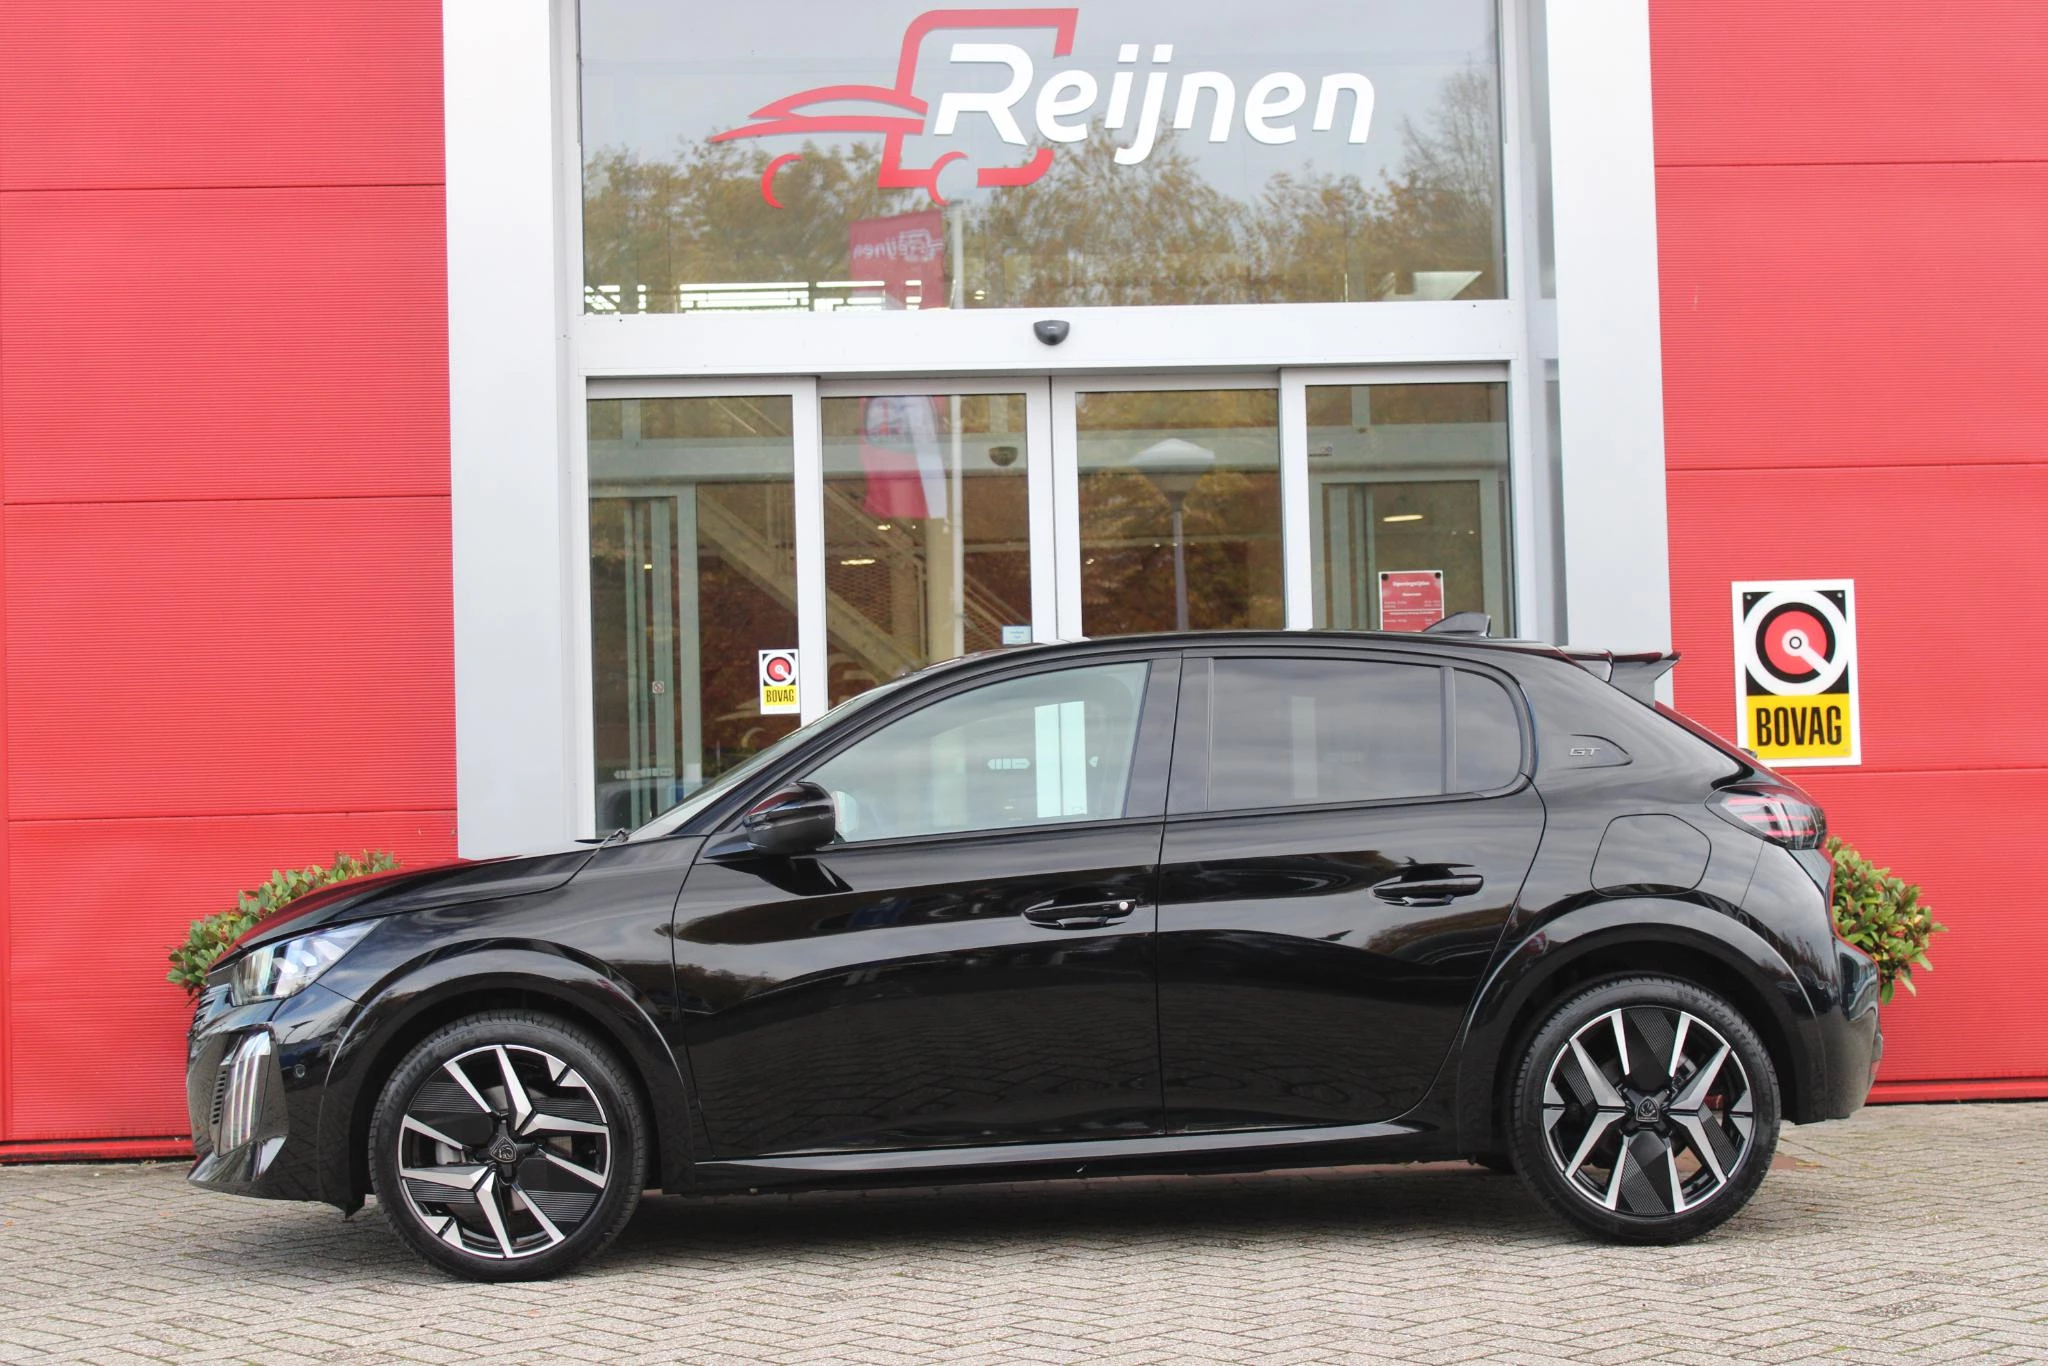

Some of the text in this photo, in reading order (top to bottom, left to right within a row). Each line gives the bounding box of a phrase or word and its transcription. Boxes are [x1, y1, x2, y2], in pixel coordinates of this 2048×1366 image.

[933, 43, 1375, 165] Reijnen
[766, 689, 795, 703] BOVAG
[1756, 705, 1842, 747] BOVAG
[1569, 747, 1600, 756] GT
